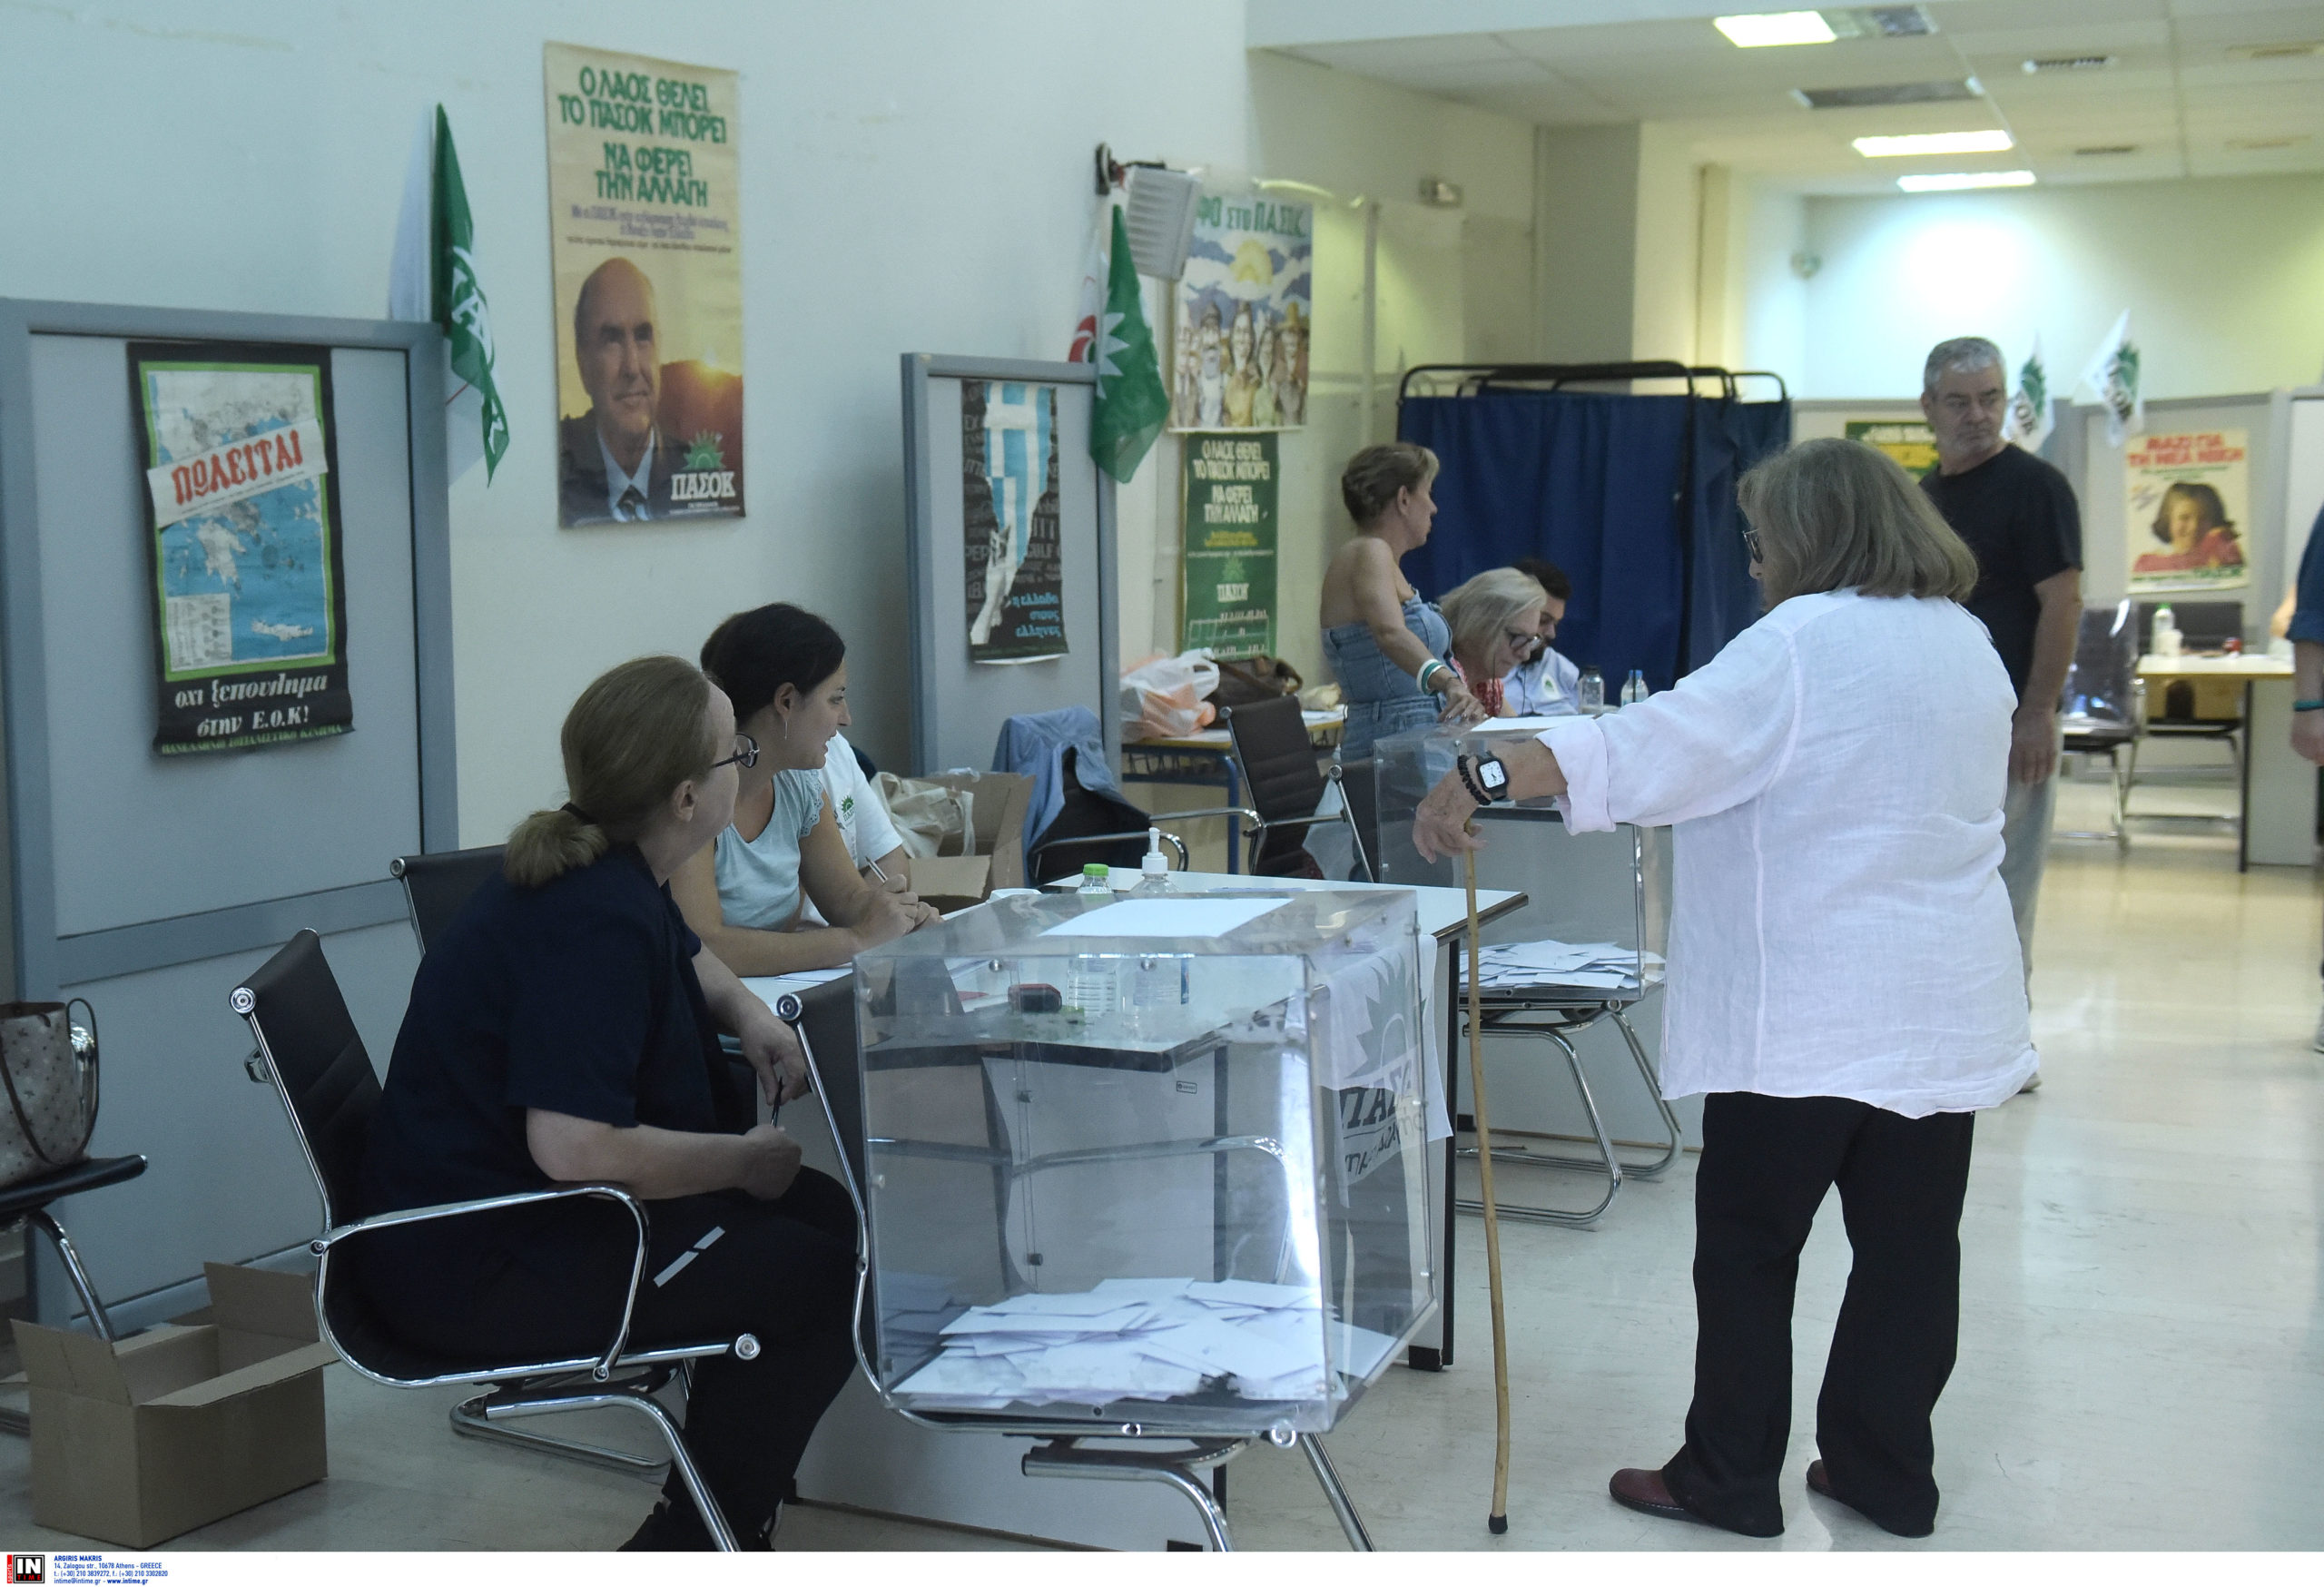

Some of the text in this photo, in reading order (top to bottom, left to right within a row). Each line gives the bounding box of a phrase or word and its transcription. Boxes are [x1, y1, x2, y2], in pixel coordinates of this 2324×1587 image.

[600, 69, 653, 104] ΛΑΟΣ
[655, 78, 711, 113] ΘΕΛΕΙ
[557, 94, 727, 144] ΤΟ ΠΑΣΟΚ ΜΠΟΡΕΙ
[603, 141, 694, 178] ΝΑ ΦΕΡΕΙ
[595, 171, 708, 208] ΤΗΝ ΑΛΛΑΓΗ
[670, 470, 736, 501] ΠΑΣΟΚ
